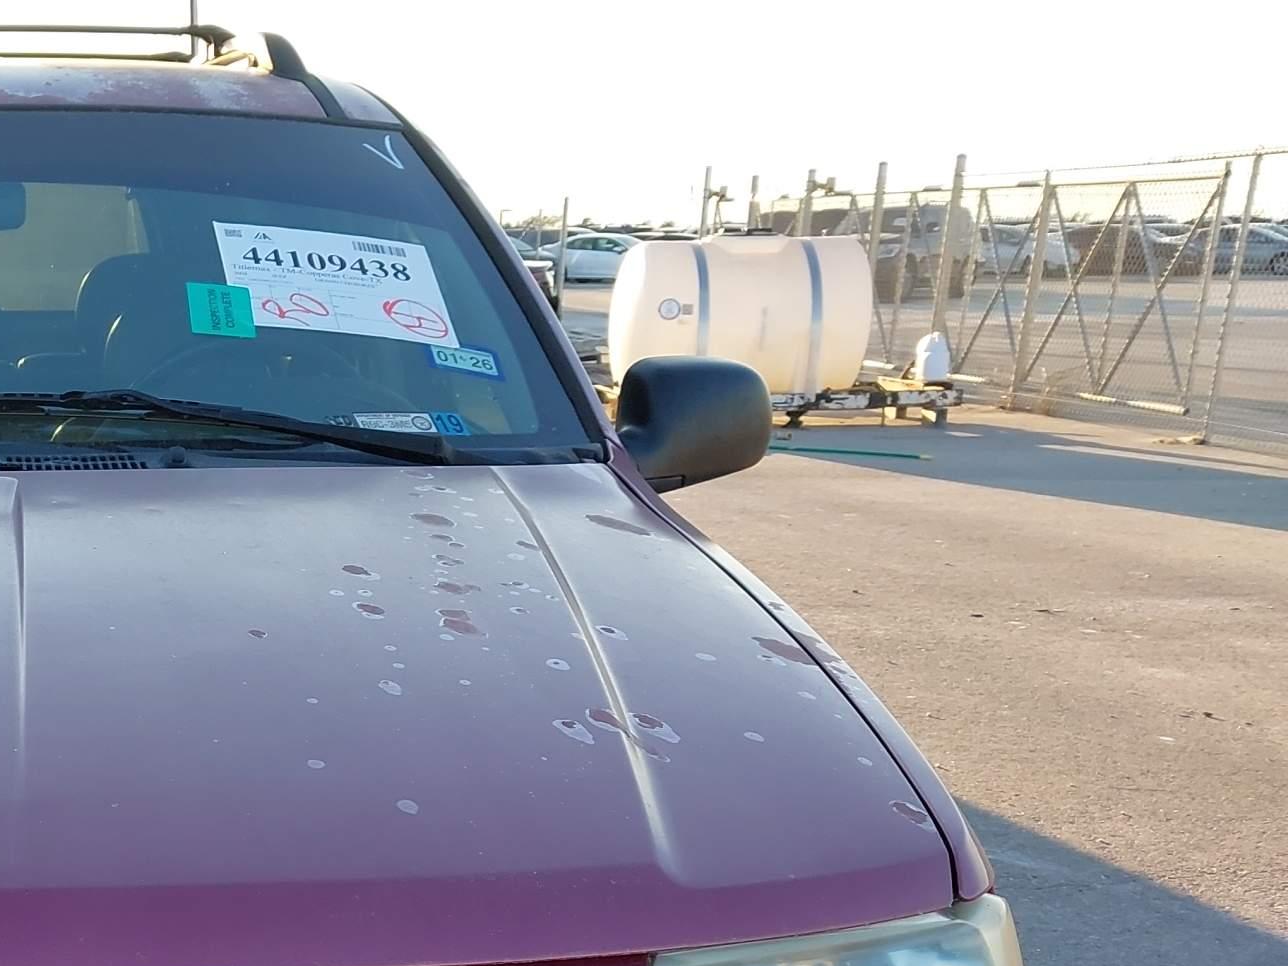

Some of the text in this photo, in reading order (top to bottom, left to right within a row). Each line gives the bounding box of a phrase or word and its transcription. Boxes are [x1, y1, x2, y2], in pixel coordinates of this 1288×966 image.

[242, 246, 412, 282] 44109438
[211, 288, 221, 331] INSPECTION
[224, 291, 235, 328] COMPLETE
[434, 413, 465, 434] 19
